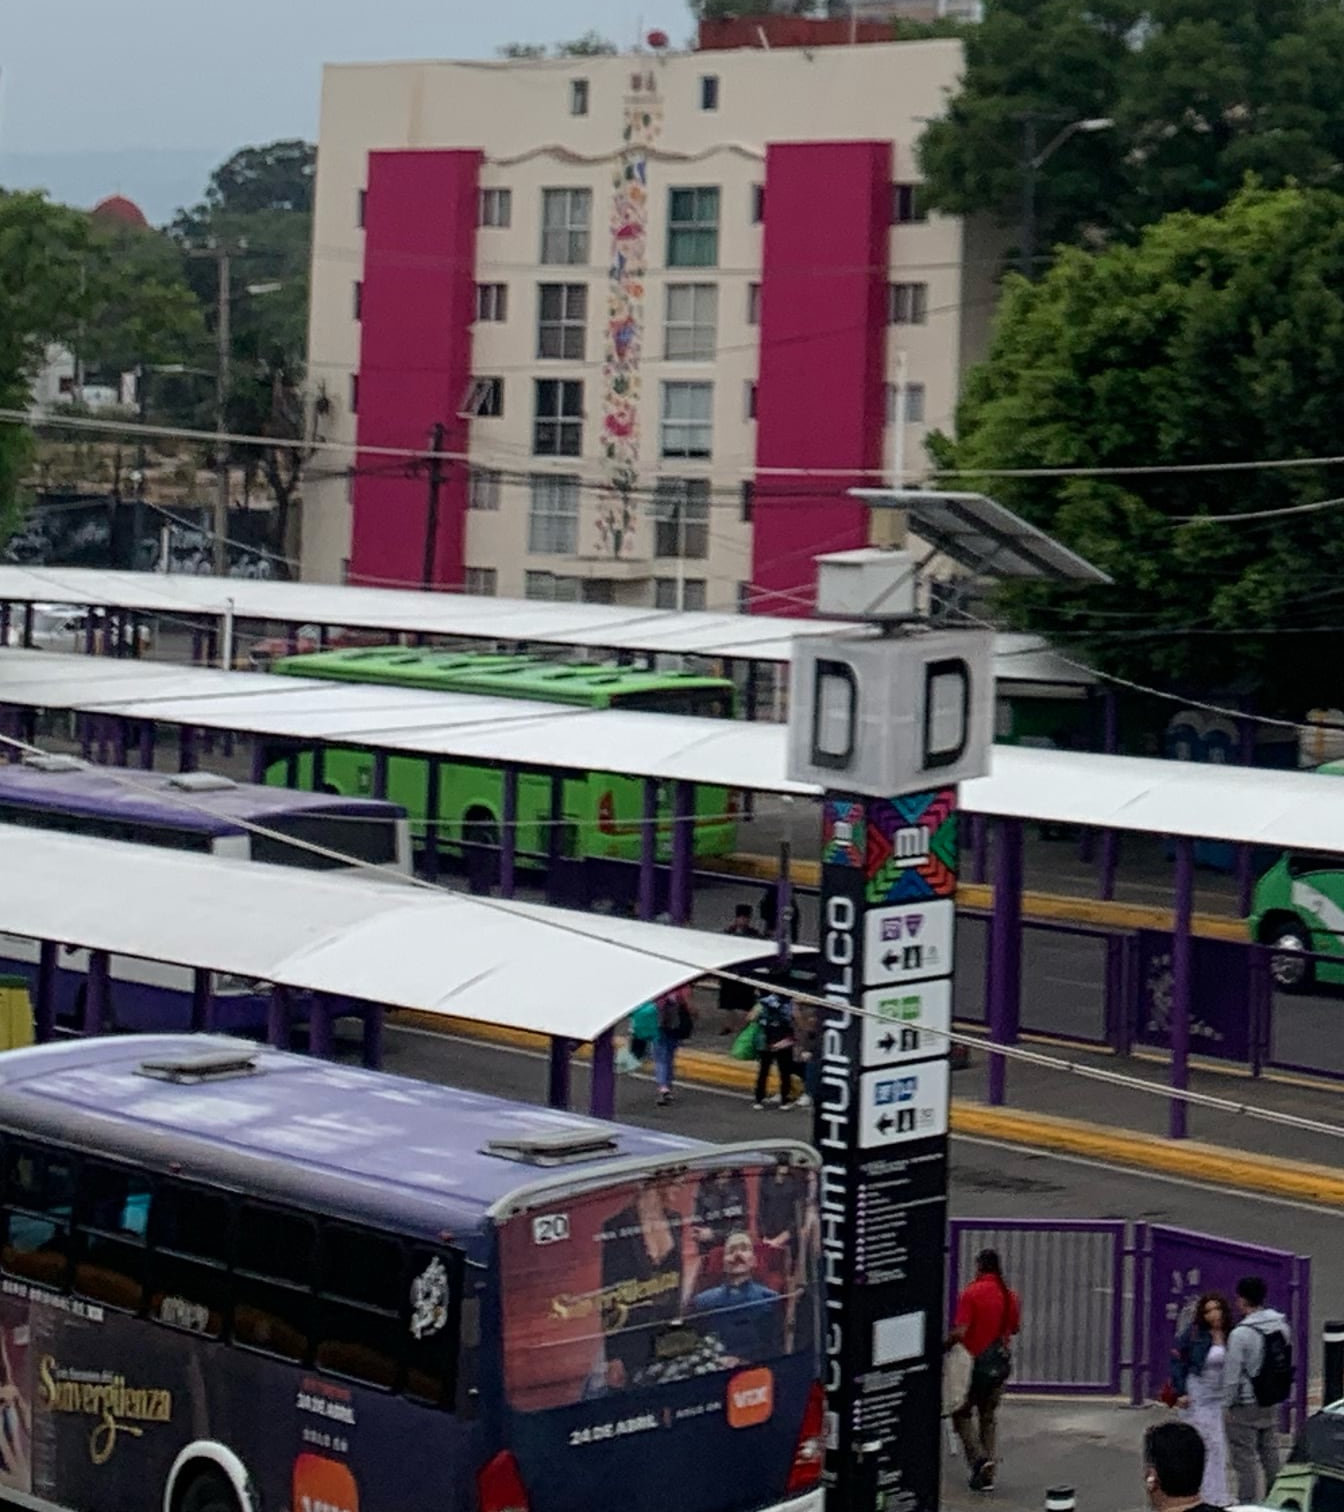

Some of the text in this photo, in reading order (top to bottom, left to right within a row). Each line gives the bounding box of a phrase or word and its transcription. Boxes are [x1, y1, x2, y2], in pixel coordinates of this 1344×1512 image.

[811, 657, 860, 772] D
[922, 656, 971, 771] D
[820, 896, 855, 1149] HUIPULCO
[538, 1216, 567, 1241] 20
